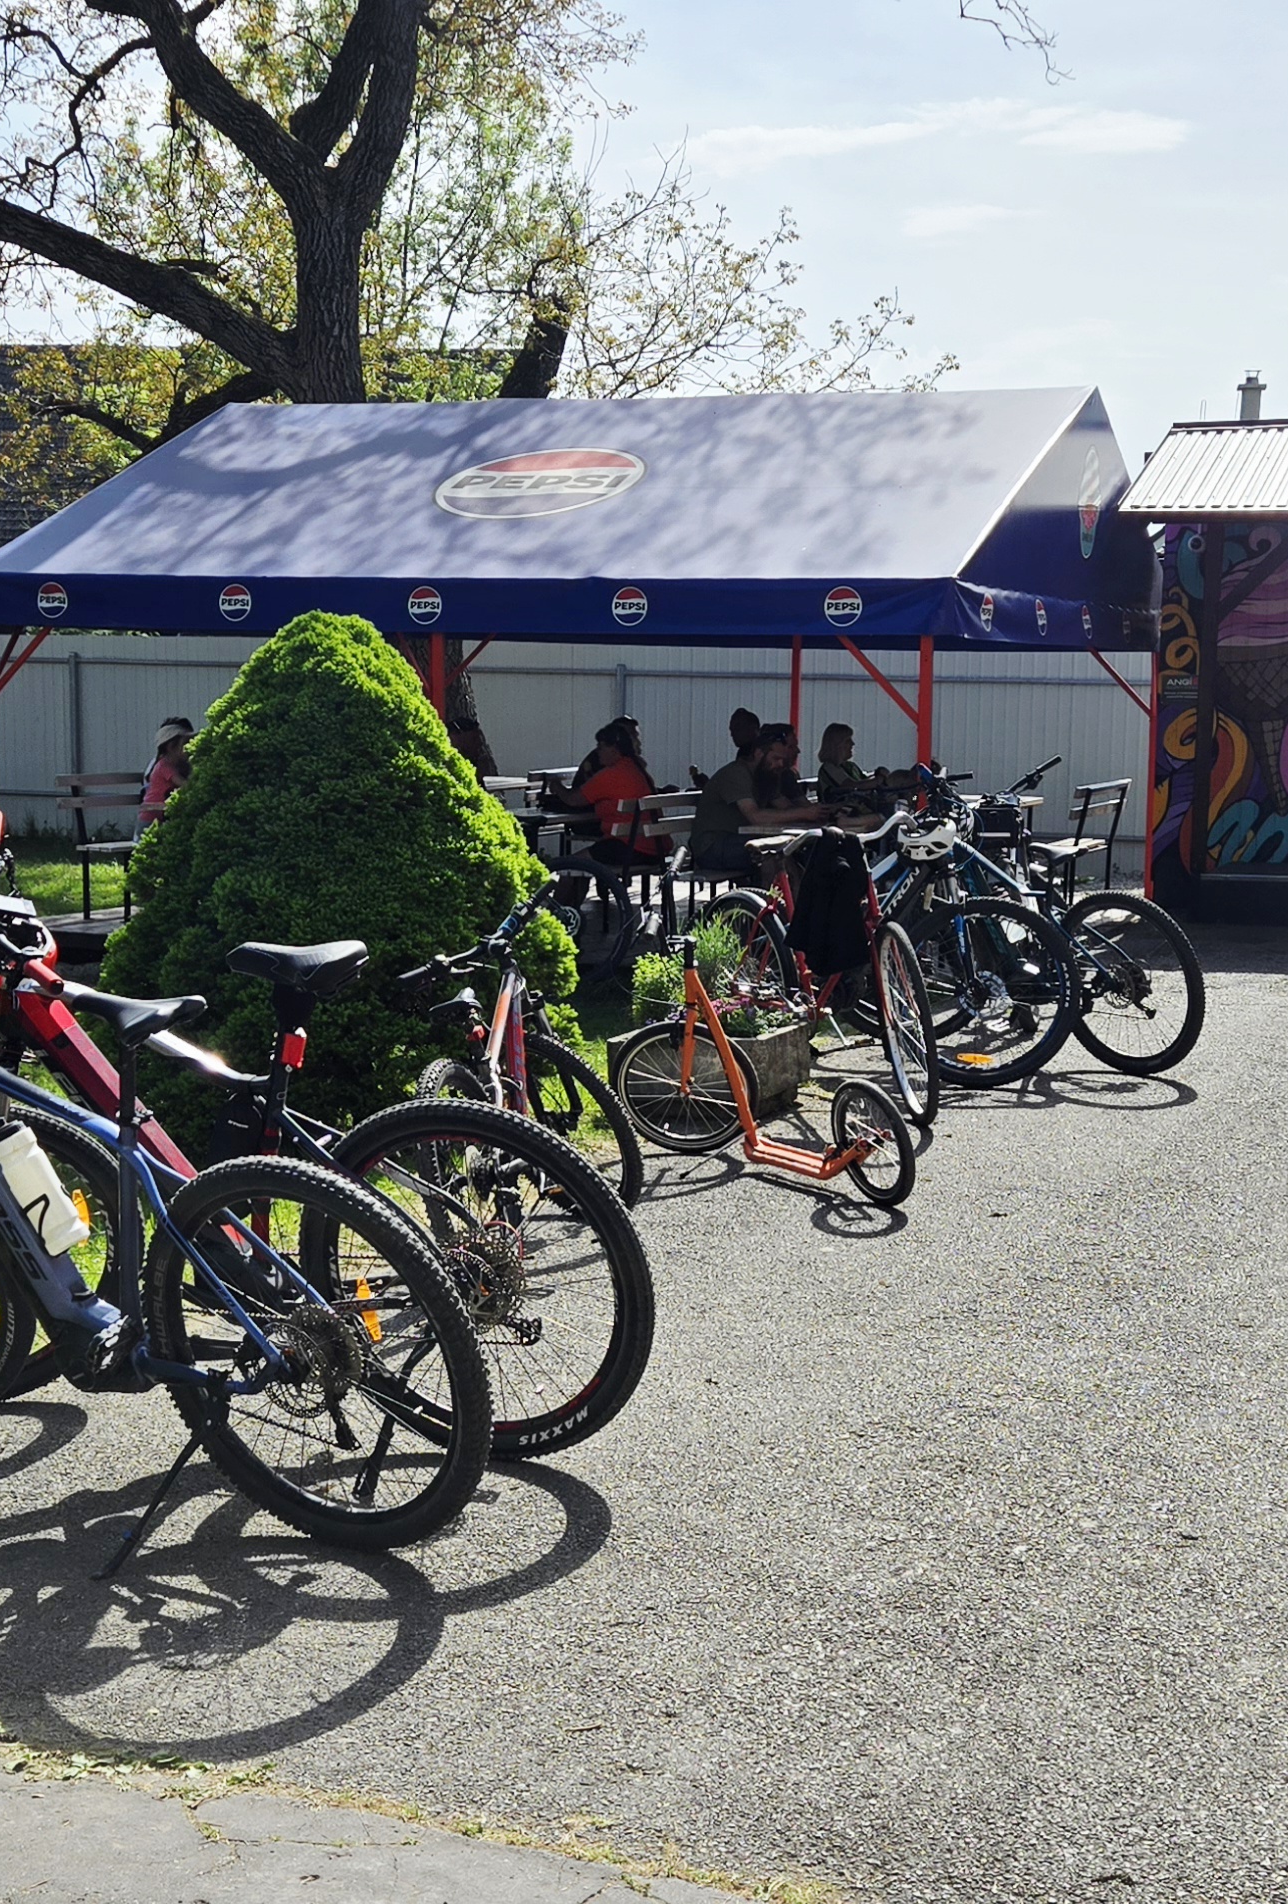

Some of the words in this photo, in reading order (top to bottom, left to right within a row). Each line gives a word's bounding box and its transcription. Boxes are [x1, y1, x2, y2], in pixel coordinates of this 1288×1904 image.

[451, 473, 631, 490] PEPSI
[39, 595, 66, 606] PEPSI
[221, 597, 249, 607] PEPSI
[410, 601, 440, 610] PEPSI
[614, 601, 646, 611] PEPSI
[826, 602, 860, 611] PEPSI
[518, 1405, 589, 1446] MAXXIS
